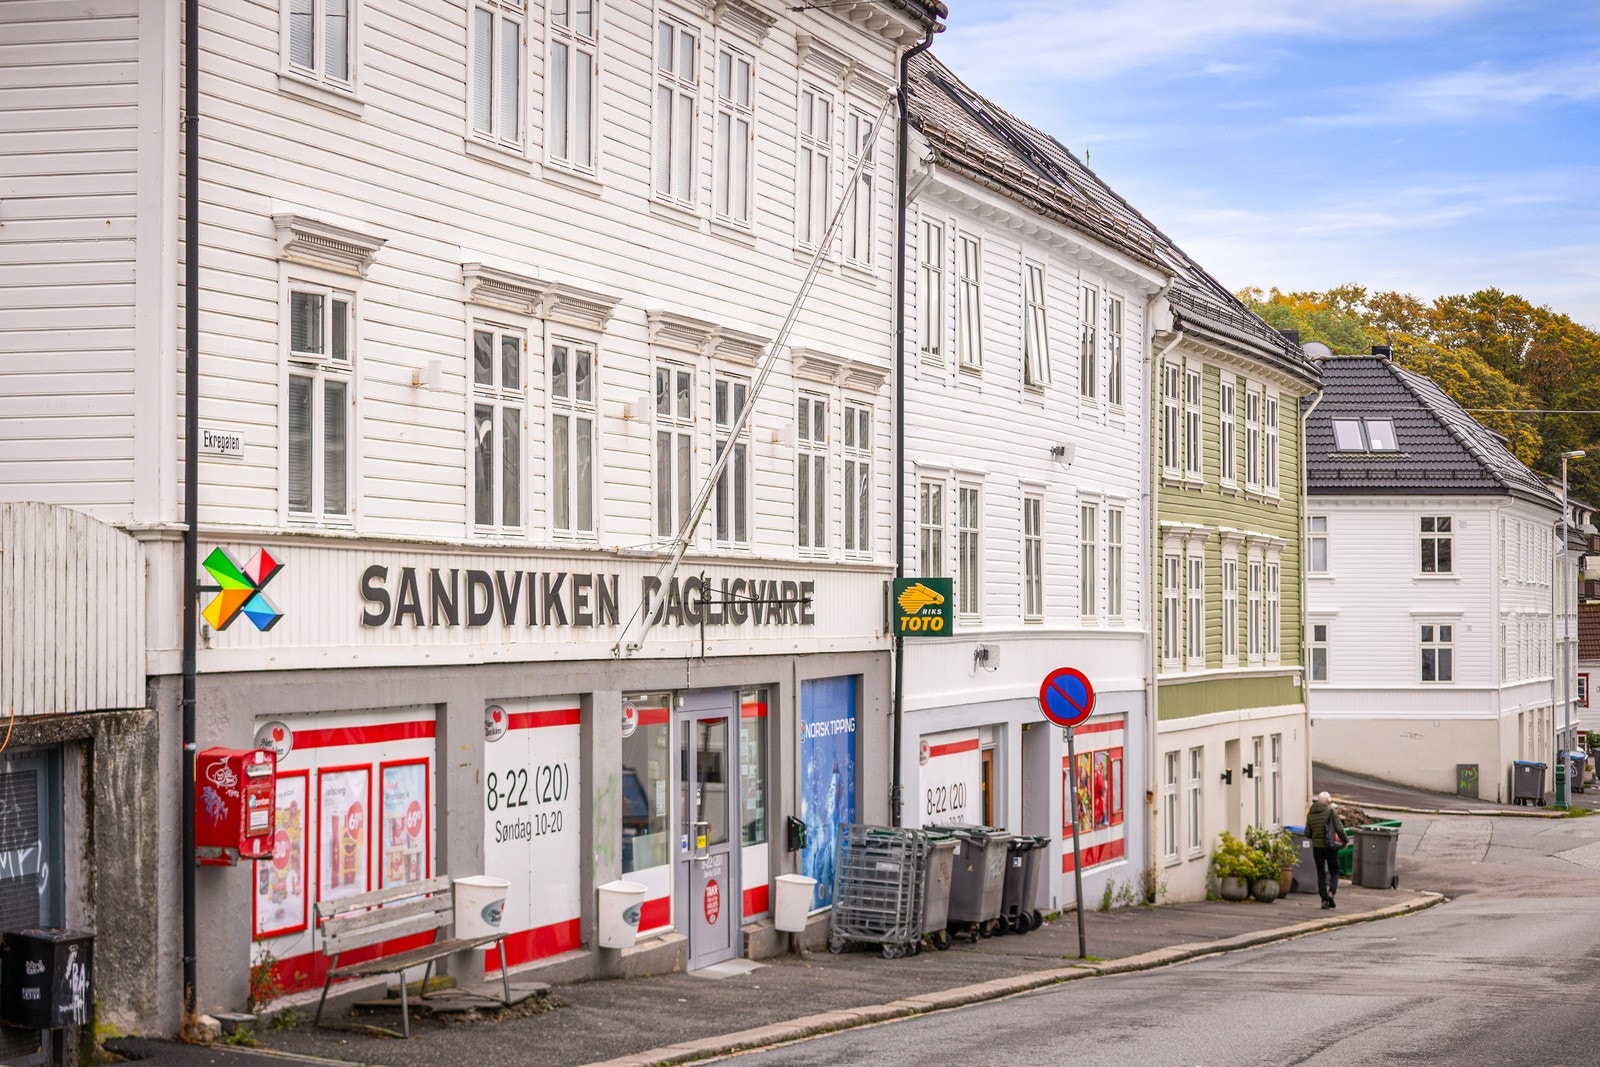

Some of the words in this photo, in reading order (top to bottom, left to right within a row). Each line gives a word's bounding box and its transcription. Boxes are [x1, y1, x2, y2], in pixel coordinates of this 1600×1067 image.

[204, 430, 239, 452] Ekregaten
[360, 564, 620, 628] SANDVIKEN
[641, 575, 815, 626] DAGLIGVARE
[900, 616, 944, 631] TOTO
[805, 721, 830, 738] NORSK
[830, 717, 856, 735] TIPPING
[487, 768, 528, 811] 8-22
[535, 762, 569, 804] (20)
[926, 786, 947, 815] 8-22
[949, 781, 967, 810] (20)
[495, 817, 532, 843] Søndag
[535, 810, 563, 836] 10-20
